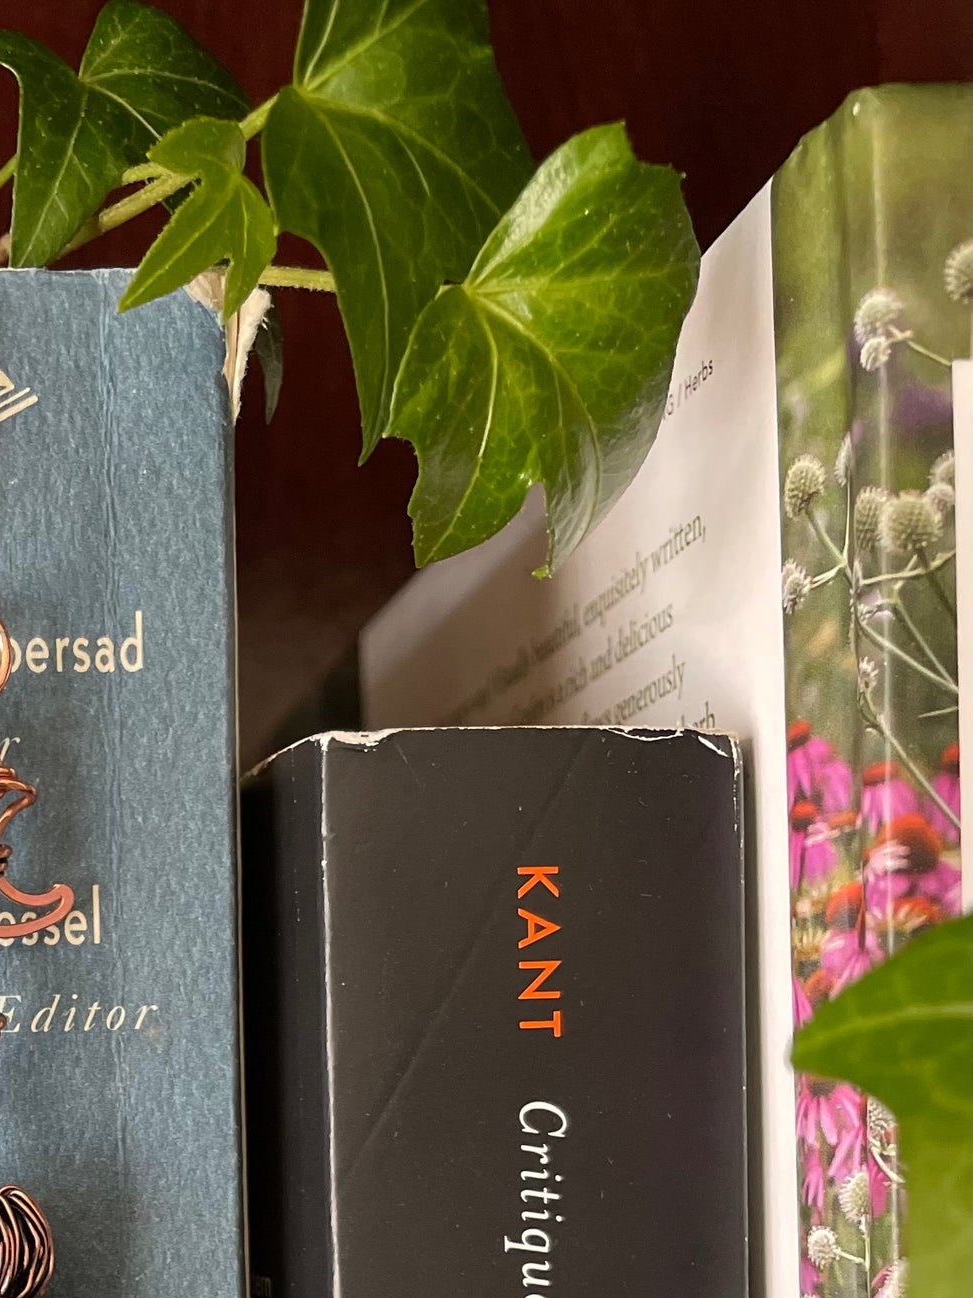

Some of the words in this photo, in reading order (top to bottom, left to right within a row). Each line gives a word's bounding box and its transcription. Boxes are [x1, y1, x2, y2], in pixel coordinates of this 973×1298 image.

[684, 360, 713, 400] Herbs
[582, 551, 649, 627] exquisitely
[650, 515, 707, 573] written,
[590, 636, 612, 682] and
[615, 603, 674, 664] delicious
[616, 653, 685, 726] generously
[516, 865, 563, 1038] KANT
